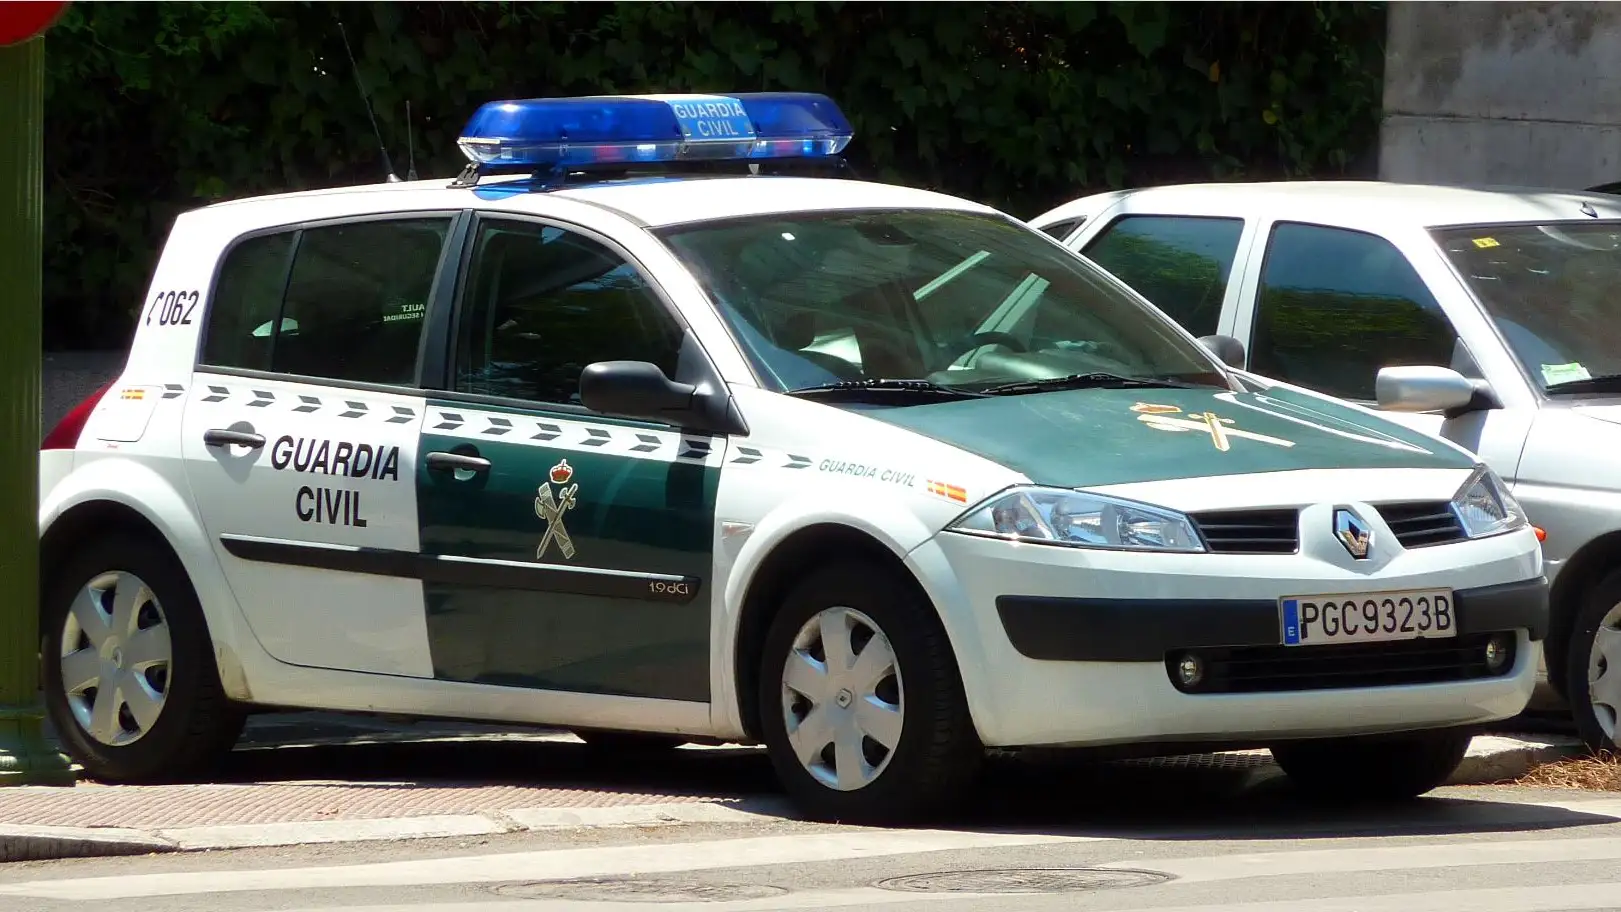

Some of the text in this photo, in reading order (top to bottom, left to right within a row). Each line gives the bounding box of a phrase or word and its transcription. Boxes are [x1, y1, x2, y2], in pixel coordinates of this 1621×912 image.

[674, 103, 746, 119] GUARDIA
[698, 120, 739, 137] CIVIL
[159, 290, 200, 326] 062
[271, 435, 400, 482] GUARDIA
[819, 459, 916, 488] GUARDIA CIVIL
[296, 485, 368, 528] CIVIL
[1287, 595, 1451, 640] E PGC9323B
